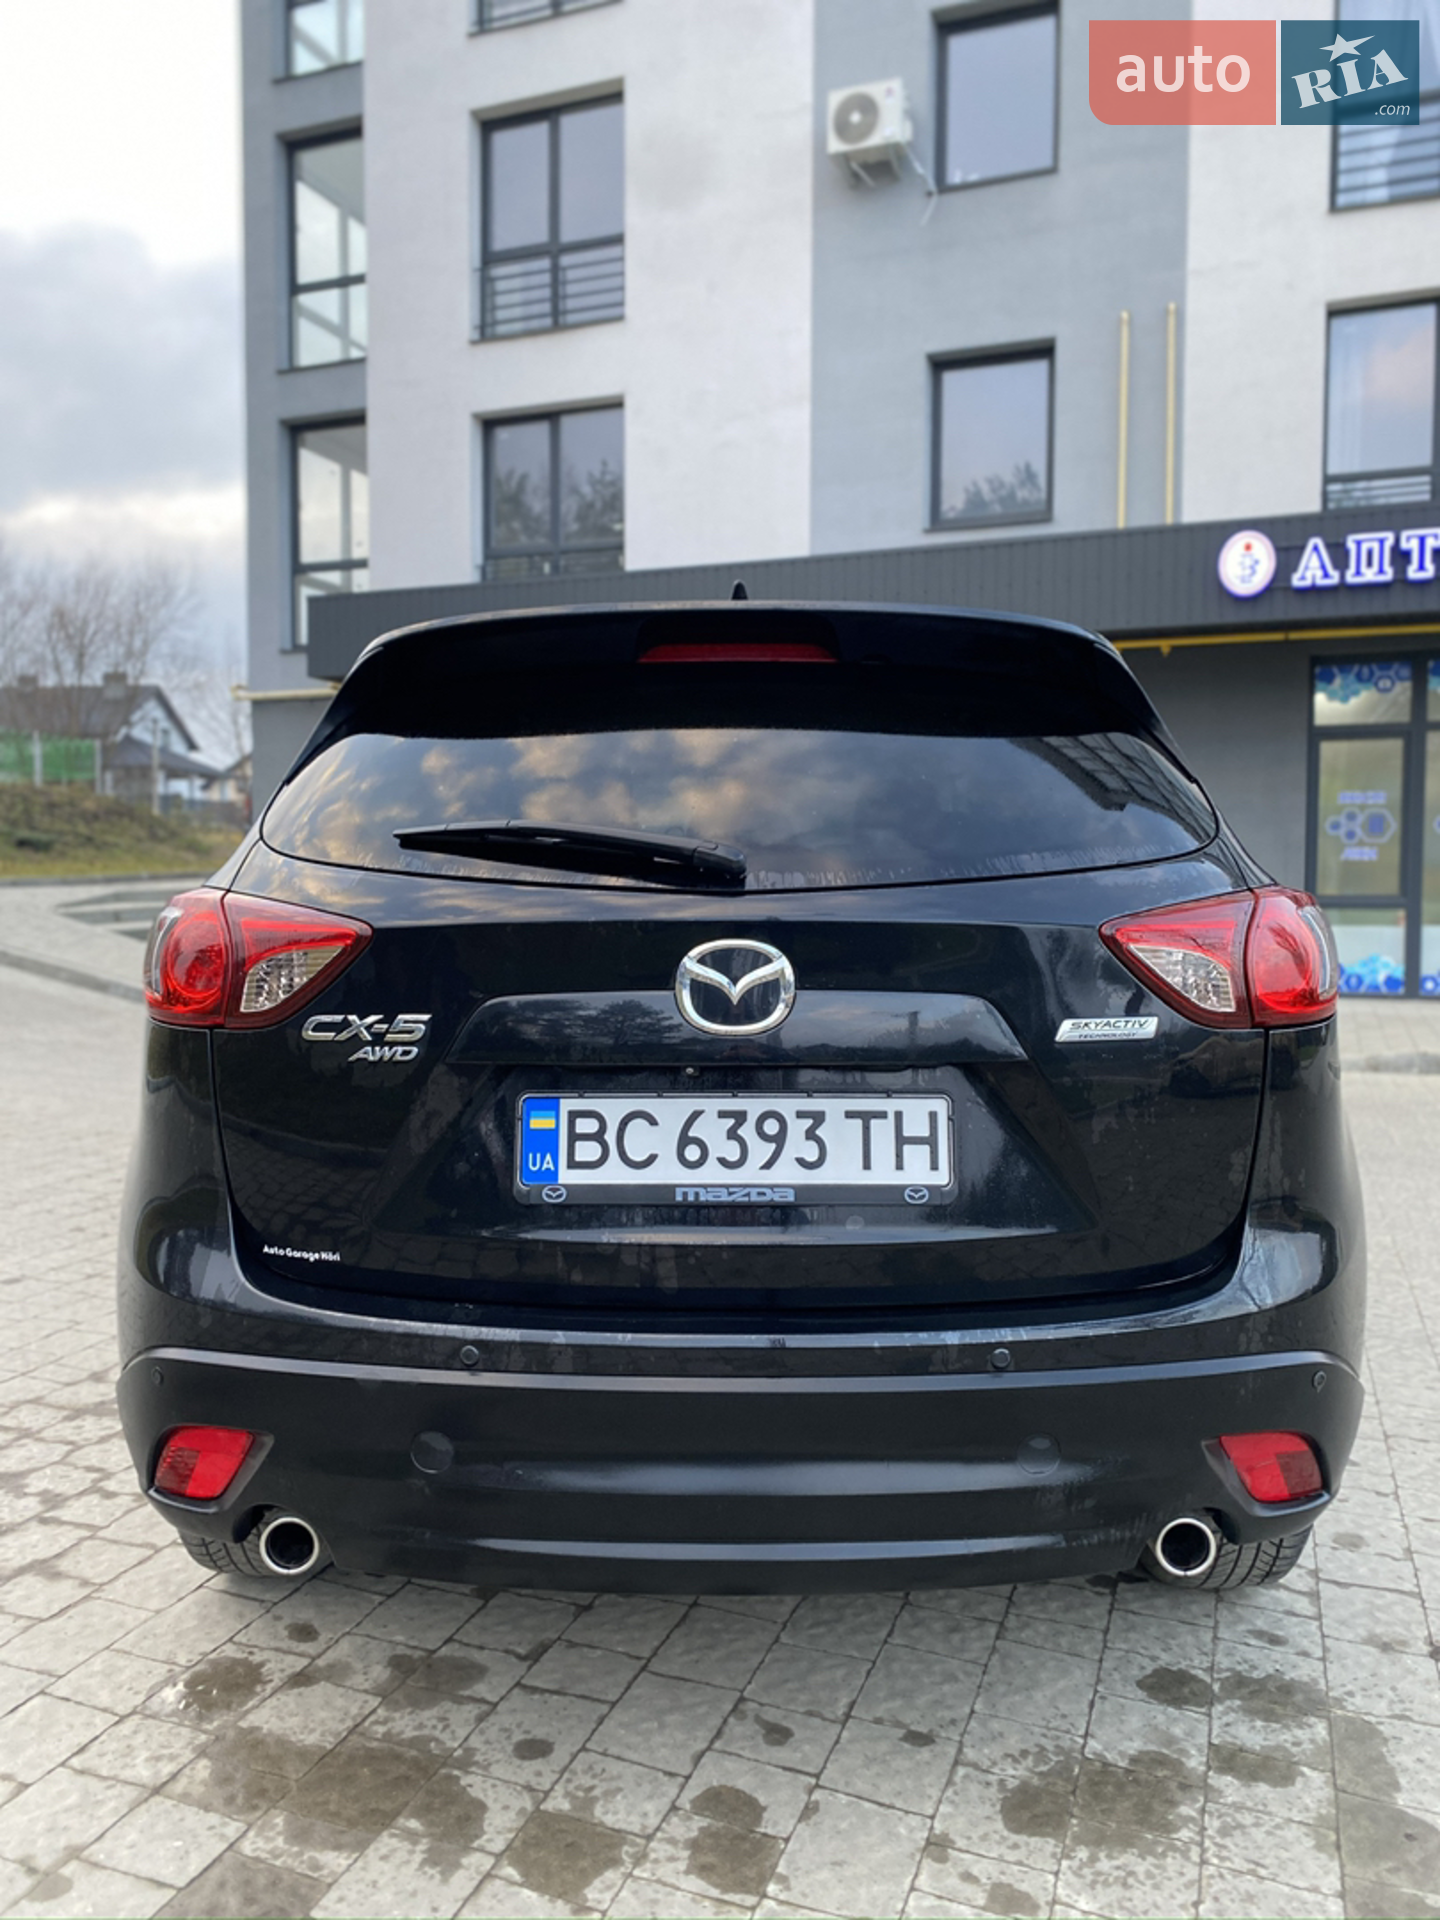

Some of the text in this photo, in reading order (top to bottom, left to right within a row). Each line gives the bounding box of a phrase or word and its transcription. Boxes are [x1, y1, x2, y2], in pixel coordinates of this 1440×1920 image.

[301, 1014, 433, 1042] CX-5
[1070, 1019, 1149, 1030] SKYACTIV
[347, 1046, 418, 1062] AWD
[566, 1109, 939, 1171] BC 6393 TH
[528, 1152, 556, 1172] UA
[263, 1244, 285, 1256] Auto
[285, 1247, 320, 1262] Garage
